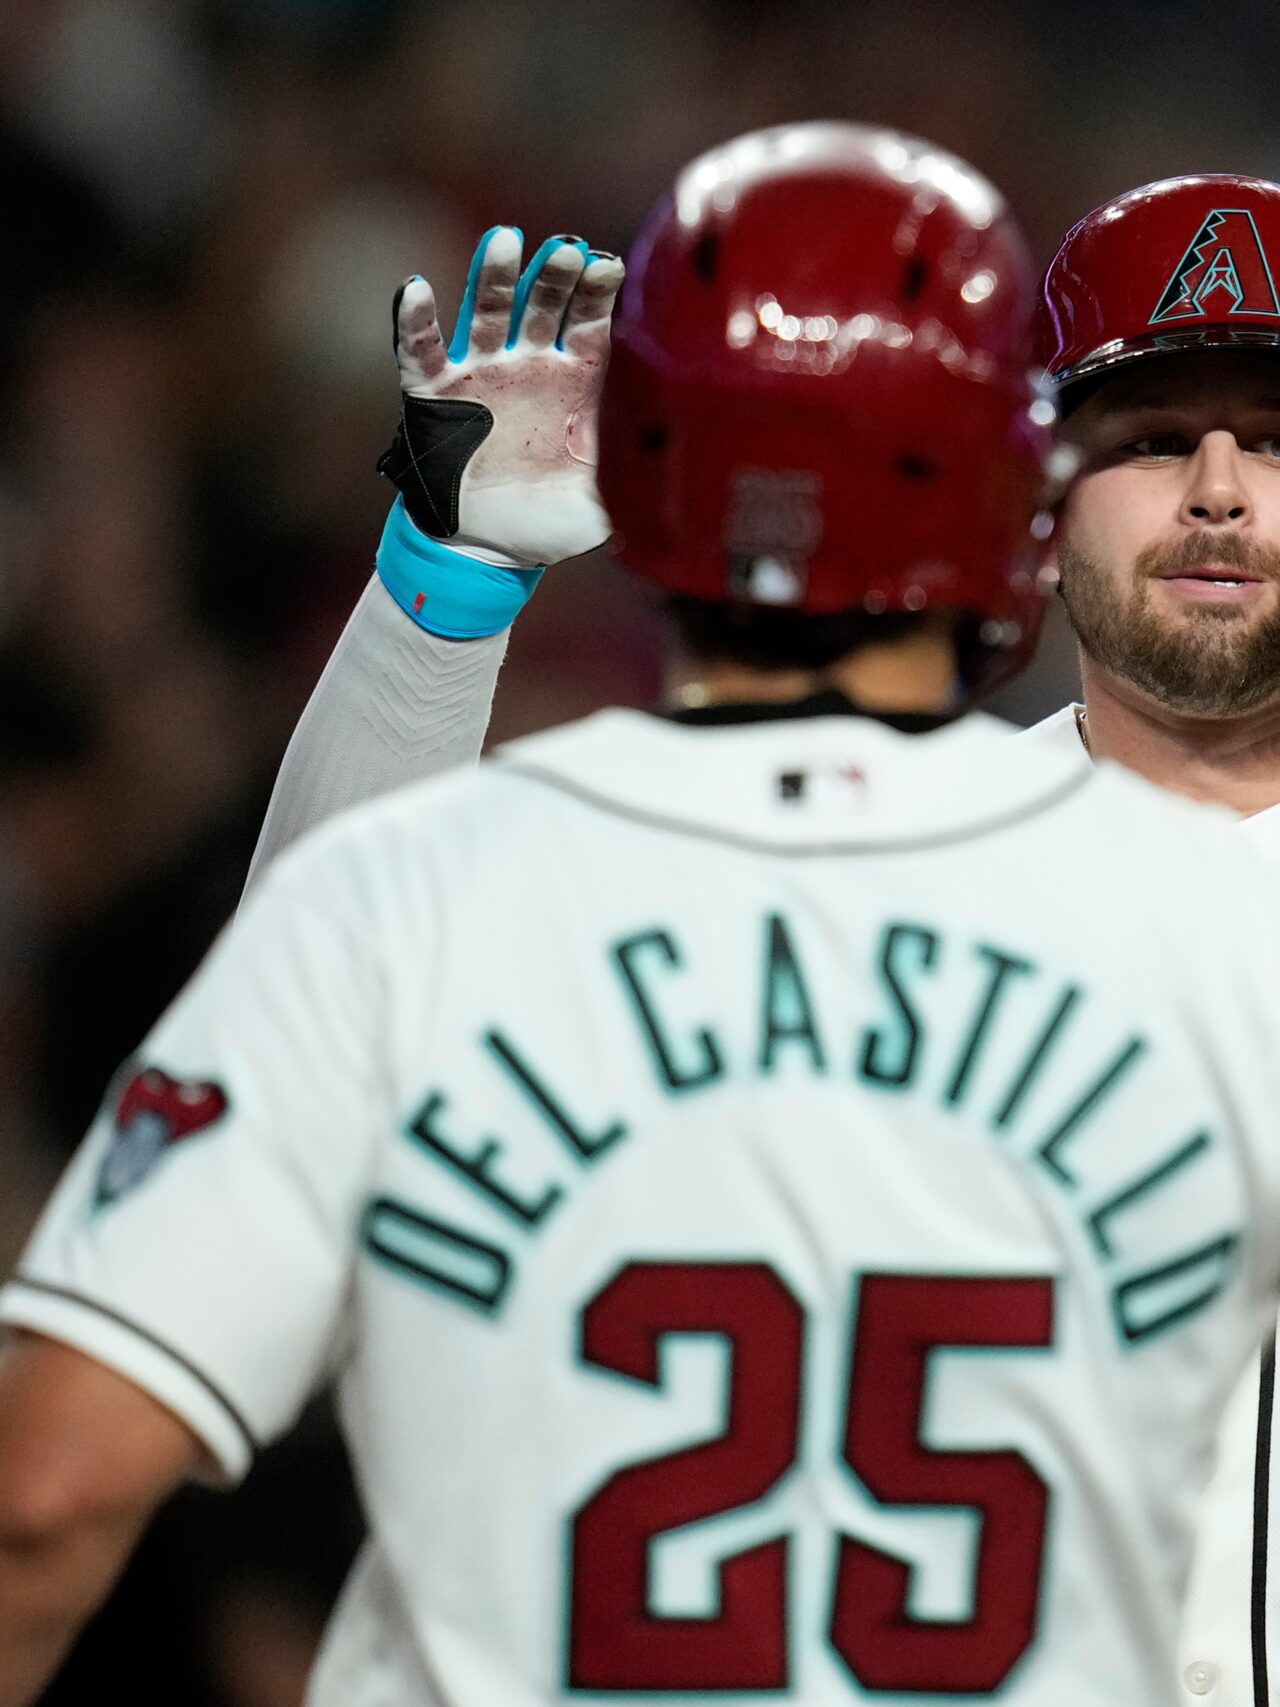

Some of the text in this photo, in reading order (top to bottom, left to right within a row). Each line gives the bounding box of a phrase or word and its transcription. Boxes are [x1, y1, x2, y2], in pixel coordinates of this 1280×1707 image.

[361, 908, 1244, 1346] DEL CASTILLO
[566, 1262, 1055, 1696] 25
